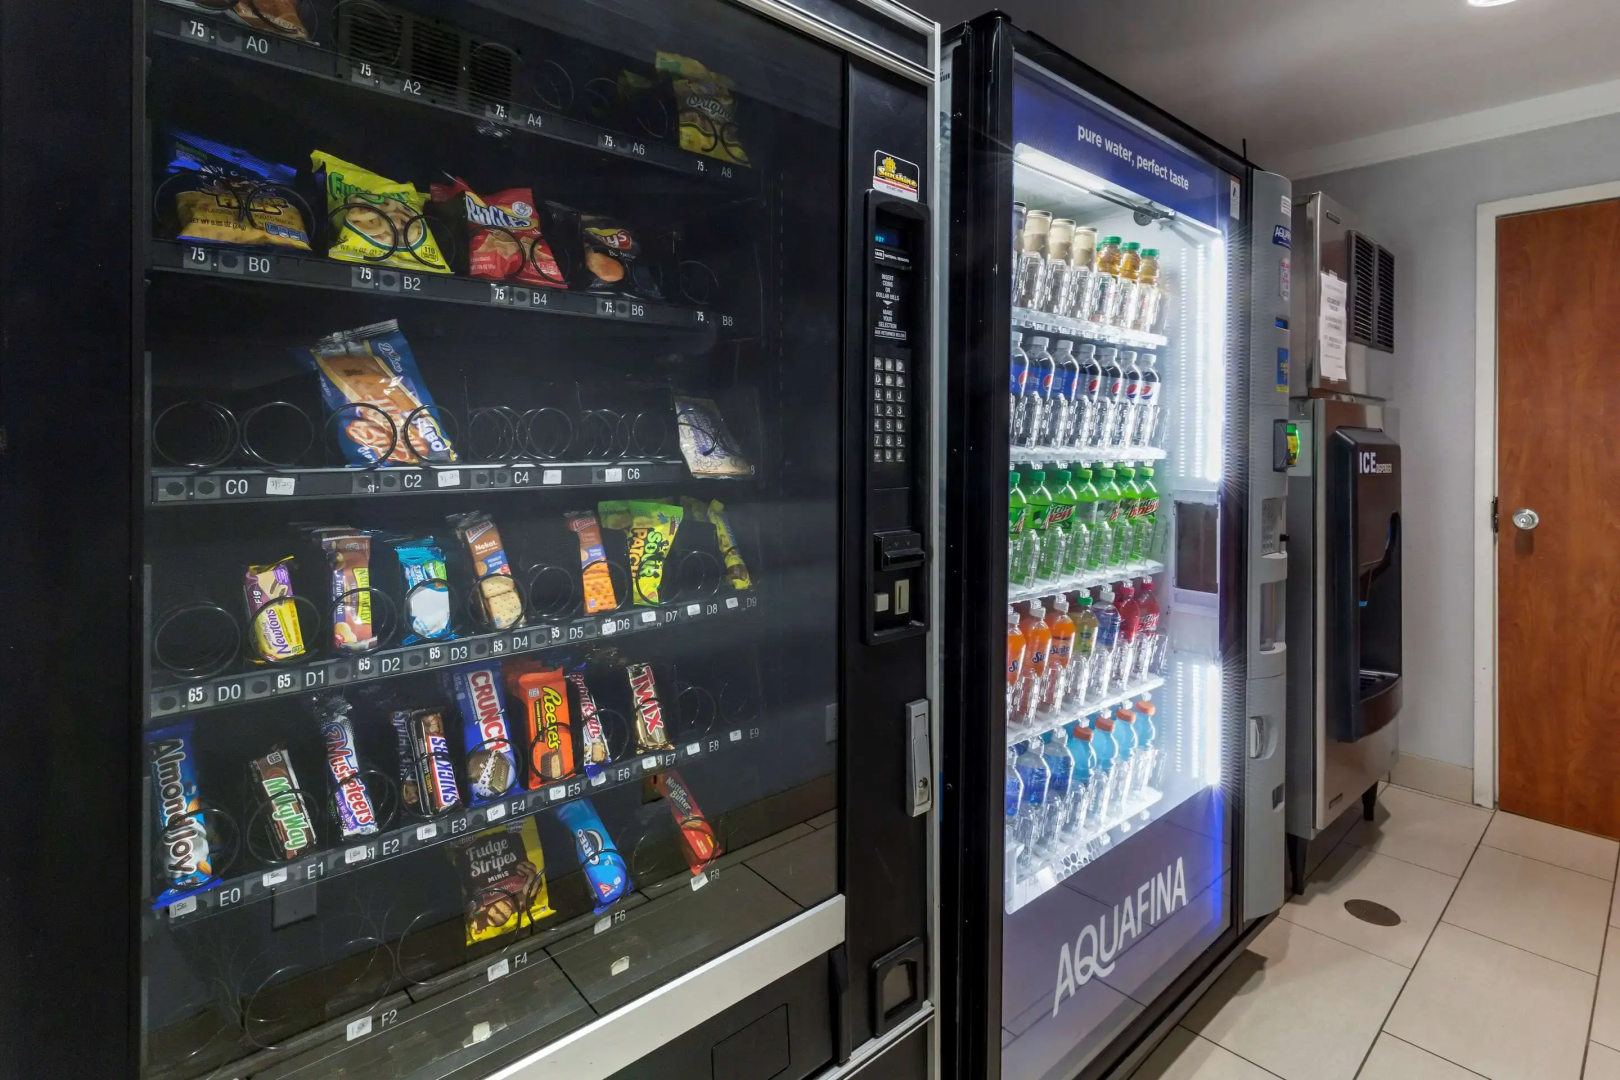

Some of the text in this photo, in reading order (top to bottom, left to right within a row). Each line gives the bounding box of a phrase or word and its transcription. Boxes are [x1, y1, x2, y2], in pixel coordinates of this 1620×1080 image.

[246, 36, 268, 54] A0
[403, 82, 421, 96] A2
[527, 113, 542, 128] A4
[632, 142, 645, 155] A6
[1078, 125, 1189, 191] pure water, perfect taste
[721, 166, 732, 178] A8
[877, 165, 917, 188] Sunshine
[465, 194, 531, 228] BUGLES
[249, 258, 270, 273] B0
[404, 277, 421, 291] B2
[882, 273, 894, 281] INSERT
[882, 280, 894, 288] COINS
[533, 292, 547, 305] B4
[875, 291, 889, 299] DOLLAR
[631, 304, 644, 317] B6
[722, 315, 733, 327] B8
[878, 321, 898, 329] SELECTION
[875, 389, 902, 400] G H J
[875, 405, 902, 415] 1 2 3
[874, 420, 902, 430] 4 5 6
[874, 435, 902, 445] 7 8 9
[1359, 451, 1392, 474] ICE DISPENSER
[404, 474, 422, 488] C2
[514, 471, 529, 484] C4
[627, 468, 640, 480] C6
[225, 479, 248, 495] C0
[335, 580, 343, 597] Fruit
[356, 570, 369, 597] NATUE
[707, 604, 718, 616] D8
[747, 597, 757, 608] D9
[665, 610, 678, 623] D7
[266, 609, 292, 655] Newtons
[617, 618, 630, 631] D6
[569, 627, 584, 640] D5
[513, 635, 528, 649] D4
[451, 646, 468, 661] D3
[382, 657, 400, 673] D2
[306, 669, 325, 686] D1
[218, 684, 242, 702] D0
[632, 666, 664, 735] TWIX
[470, 671, 510, 751] CRUNCH
[541, 686, 563, 750] Reese's
[750, 728, 759, 739] E9
[709, 740, 719, 752] E8
[665, 753, 676, 766] E7
[618, 768, 630, 781] E6
[327, 740, 375, 826] Musketeers
[568, 783, 580, 797] E5
[666, 776, 688, 798] Nutter
[150, 738, 197, 874] Almond Joy
[511, 800, 526, 815] E4
[669, 790, 692, 811] Butter
[283, 812, 309, 851] Way
[451, 818, 467, 834] E3
[382, 838, 400, 856] E2
[465, 837, 509, 862] Fudge
[577, 828, 600, 866] OREO
[307, 861, 324, 880] E1
[470, 850, 517, 877] Stripes
[710, 869, 719, 881] F8
[219, 887, 241, 907] E0
[614, 910, 626, 924] F6
[1052, 856, 1188, 1018] AQUAFINA
[514, 952, 527, 968] F4
[381, 1009, 397, 1027] F2
